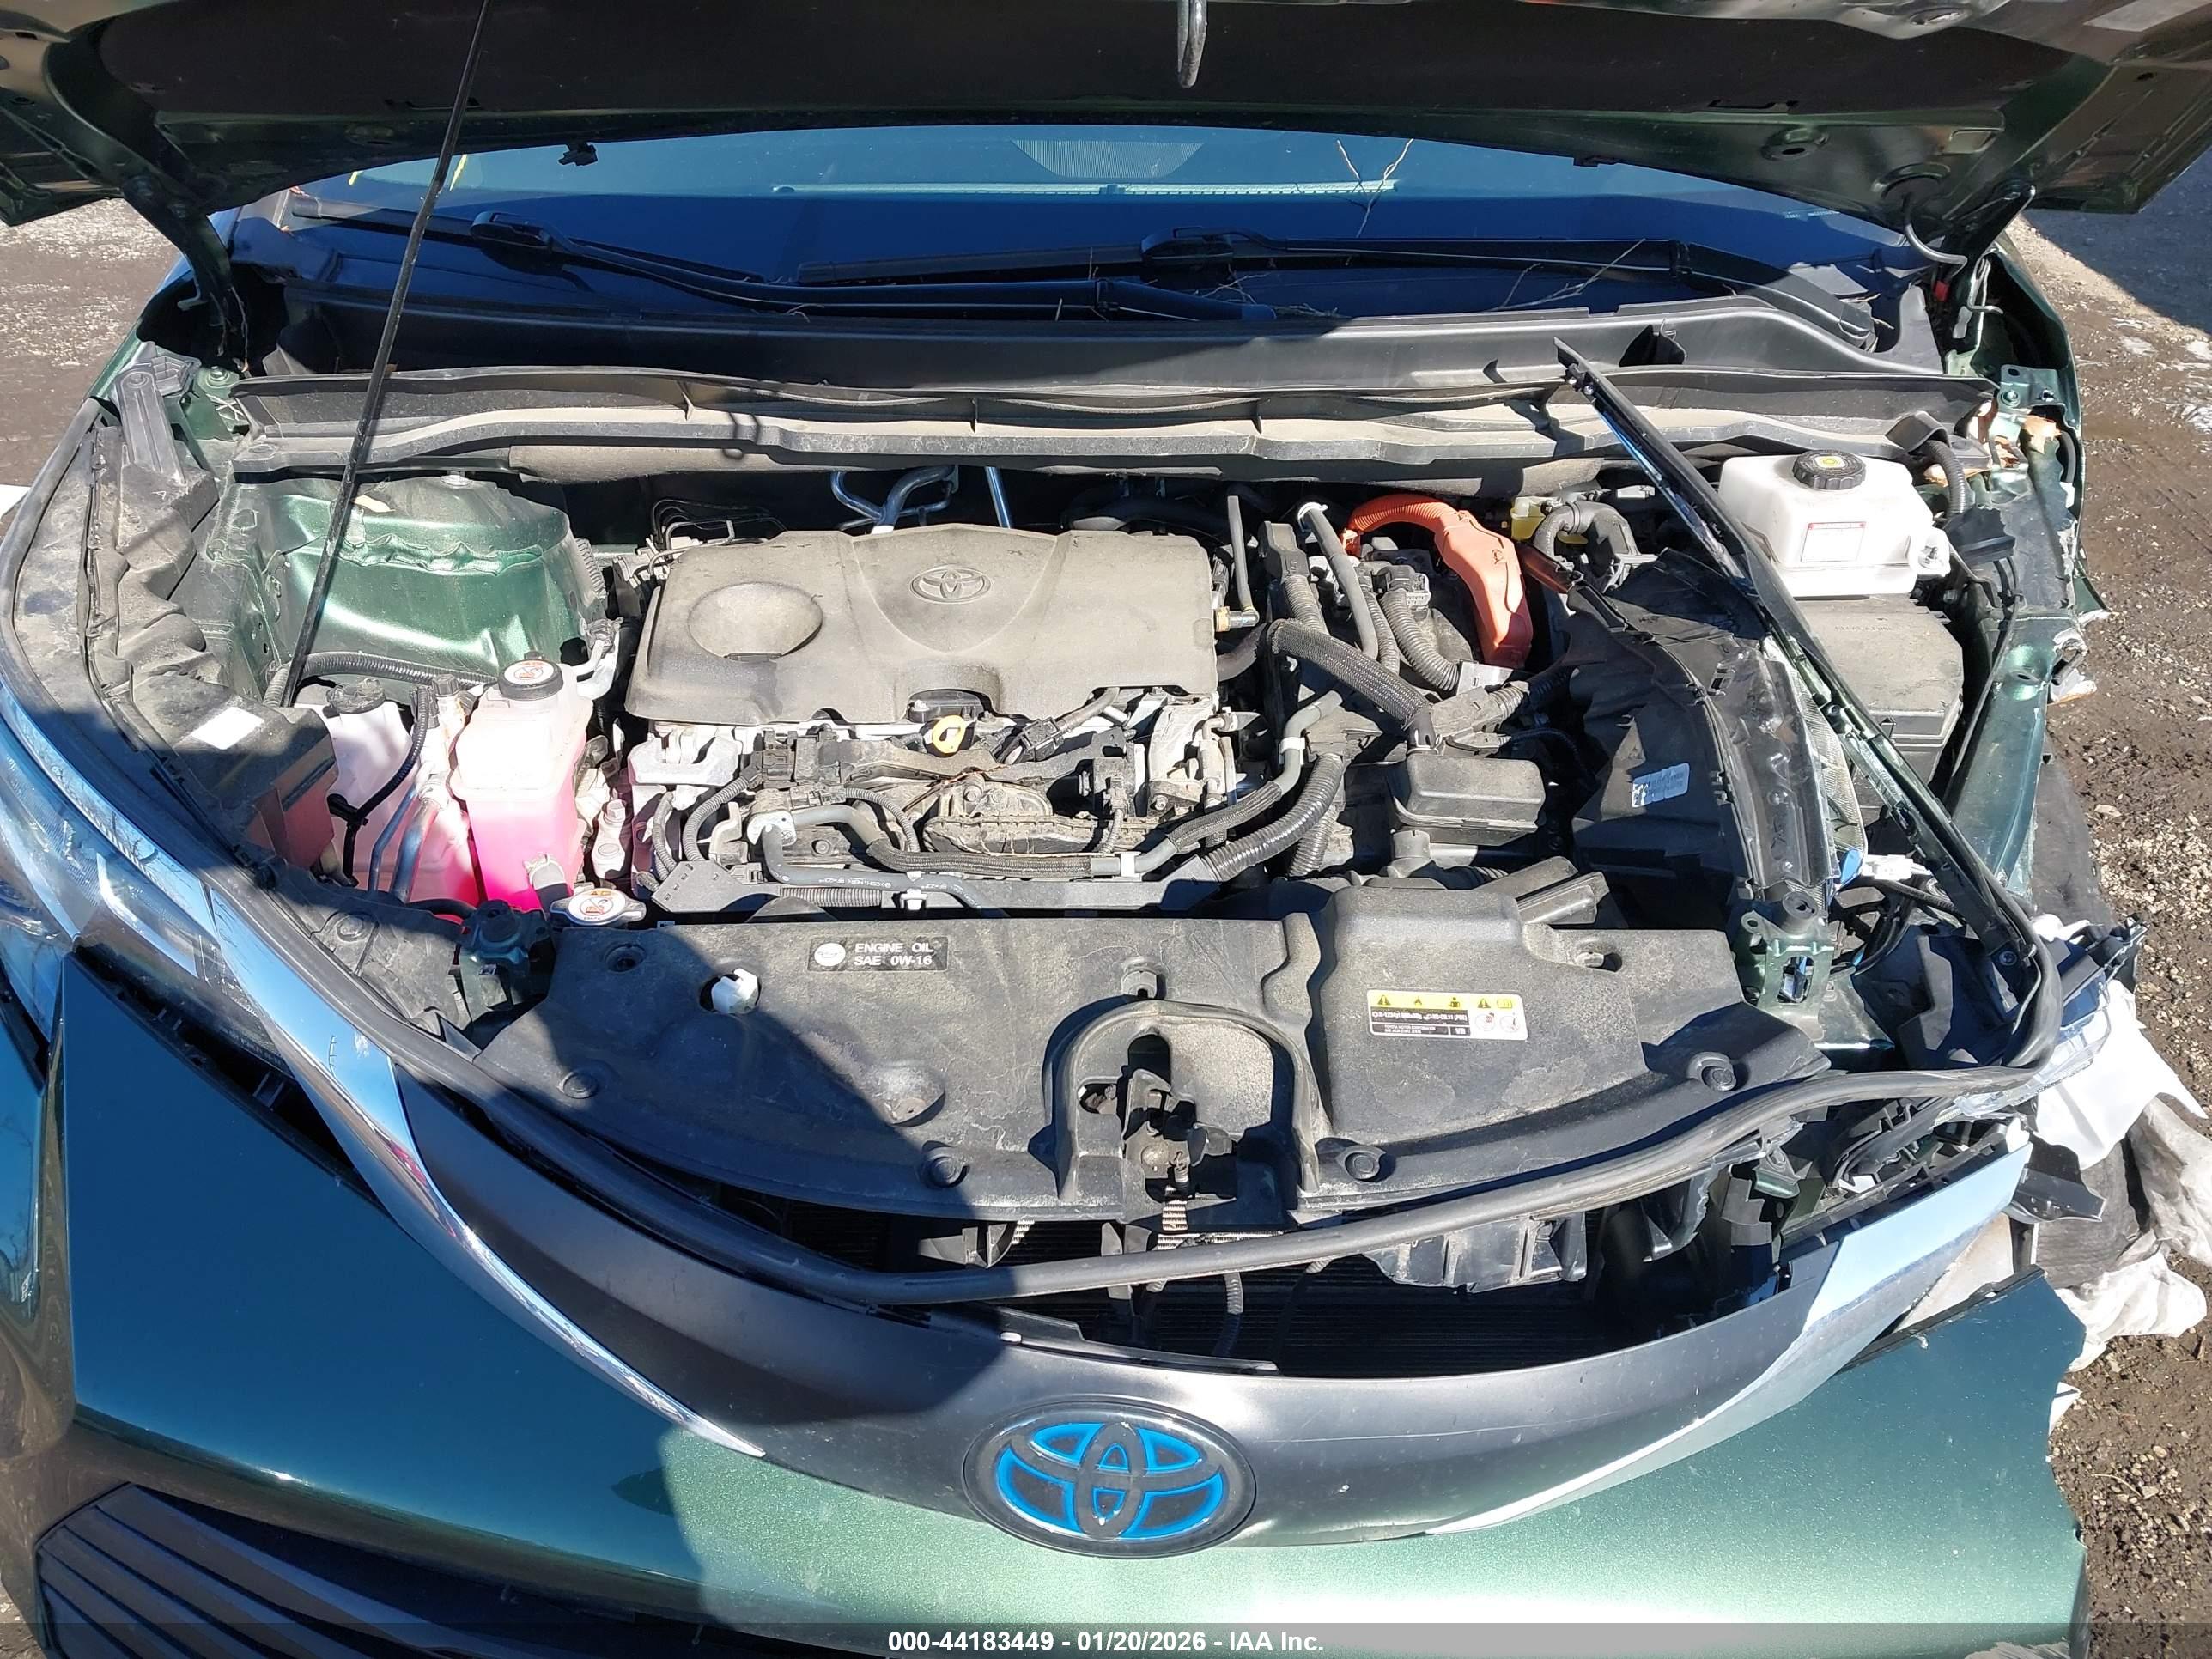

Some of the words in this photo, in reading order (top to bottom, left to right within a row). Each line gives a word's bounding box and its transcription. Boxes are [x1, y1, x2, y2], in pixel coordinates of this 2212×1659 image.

[854, 943, 903, 953] ENGINE
[911, 942, 933, 952] OIL
[854, 955, 882, 966] SAE
[890, 955, 933, 966] 0W-16
